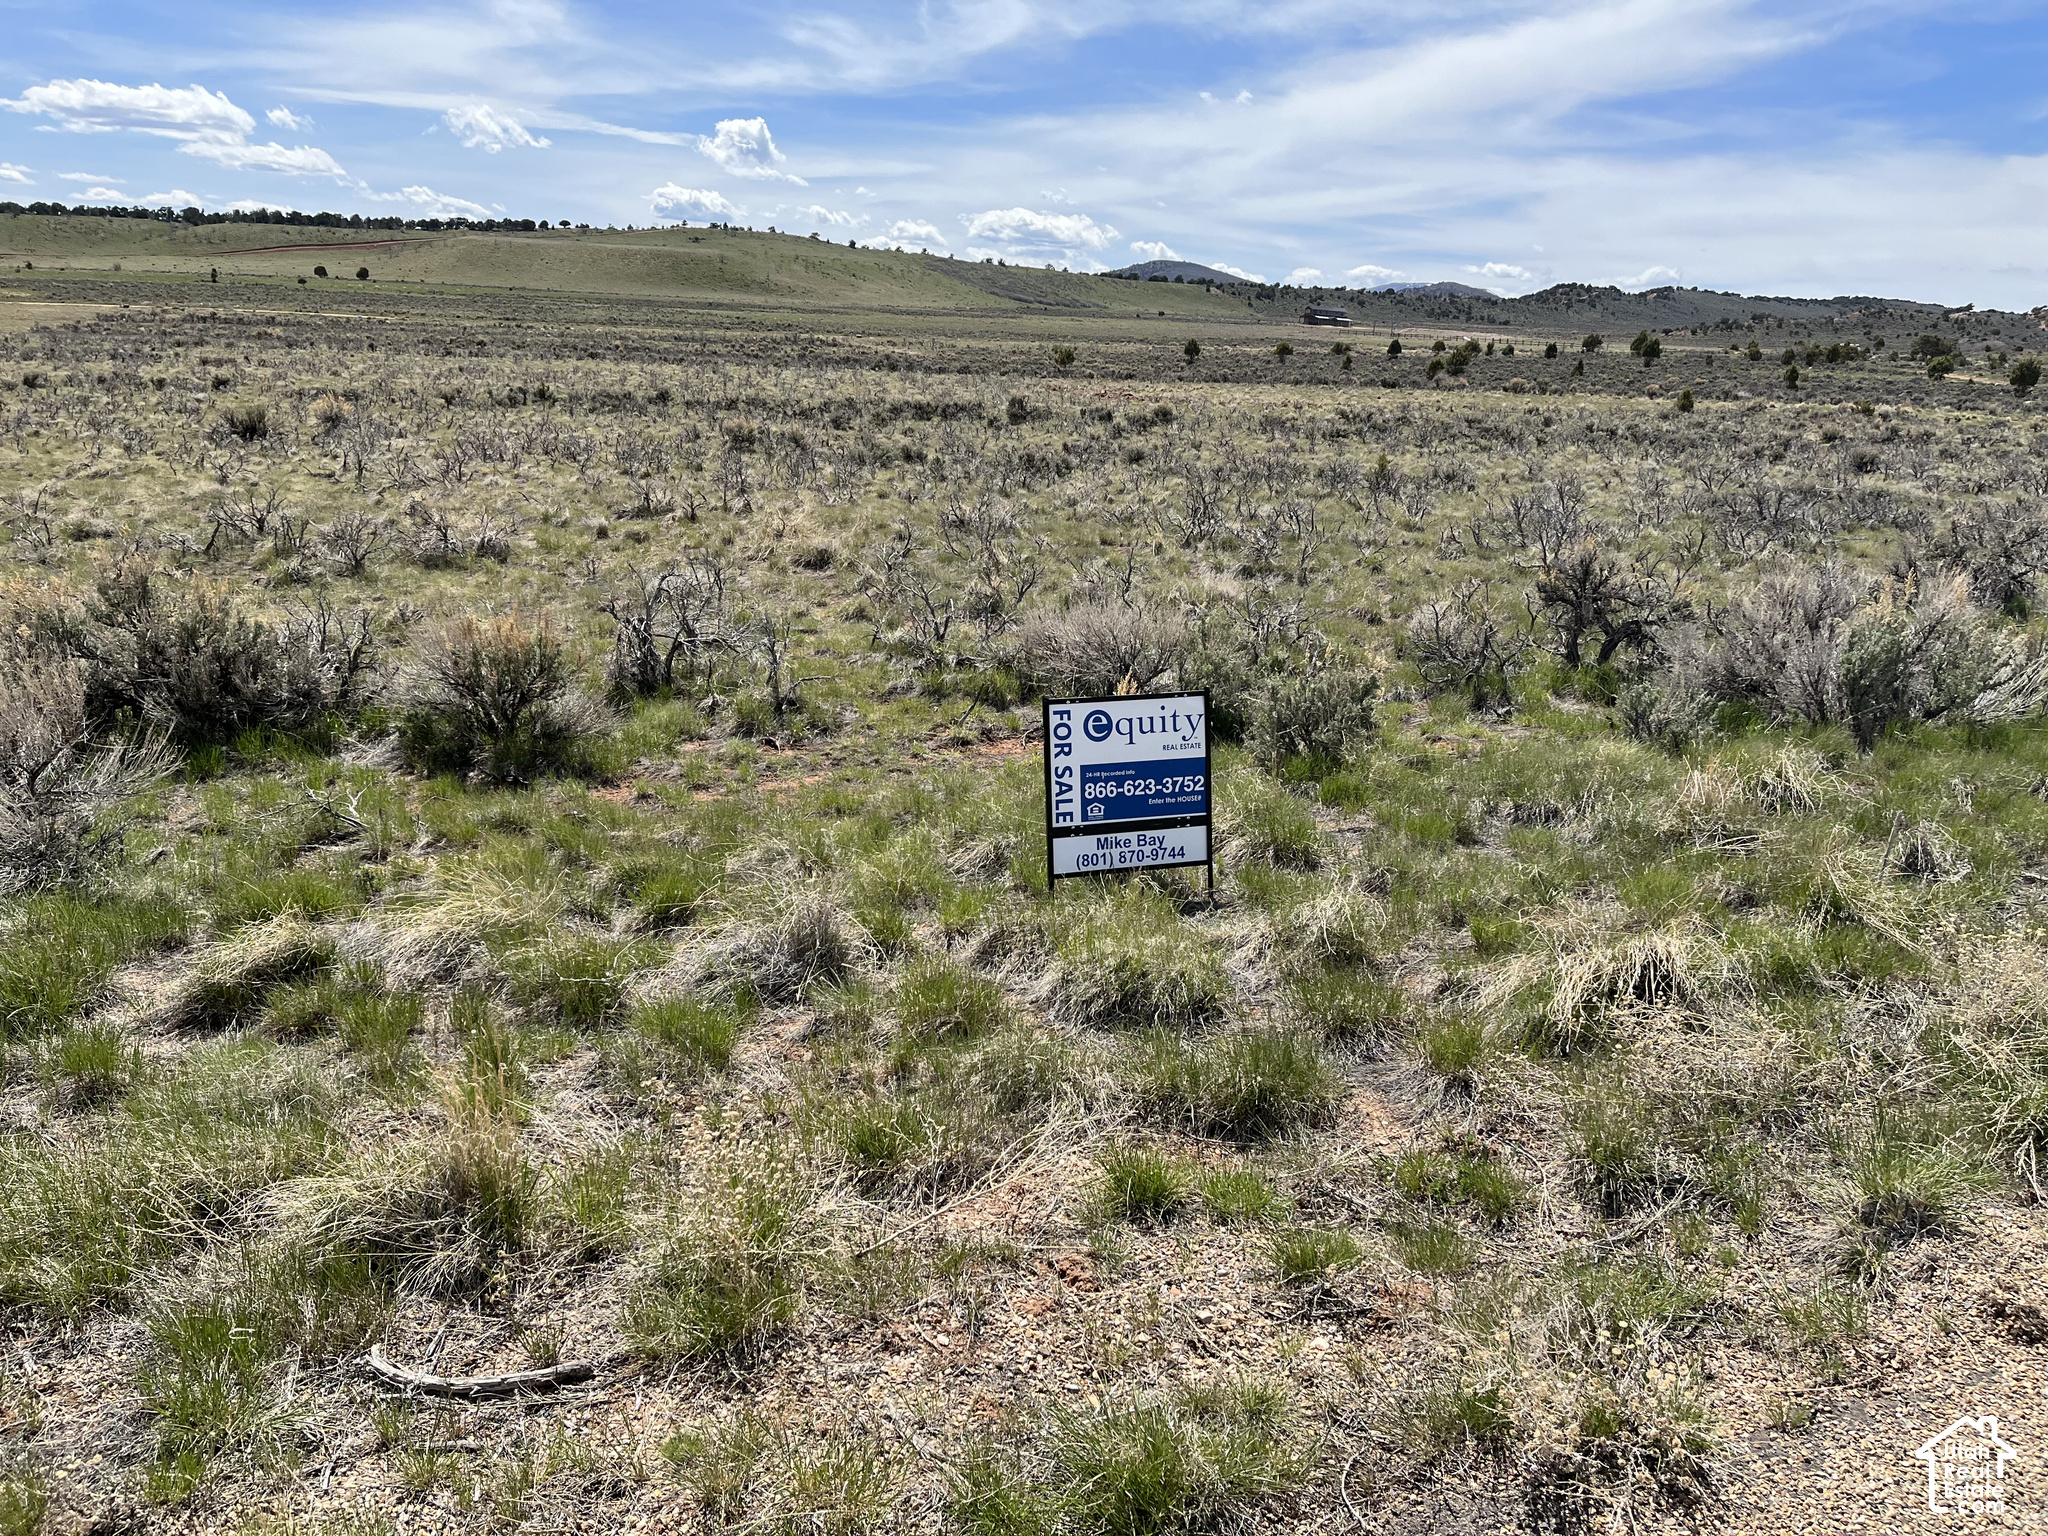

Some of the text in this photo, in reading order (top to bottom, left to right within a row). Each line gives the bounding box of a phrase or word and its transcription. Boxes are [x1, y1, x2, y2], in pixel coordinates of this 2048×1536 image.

[1083, 705, 1204, 745] equity
[1053, 710, 1073, 823] FOR SALE
[1084, 776, 1205, 799] 866-623-3752
[1096, 834, 1165, 850] Mike Bay
[1076, 846, 1185, 870] (801) 870-9744
